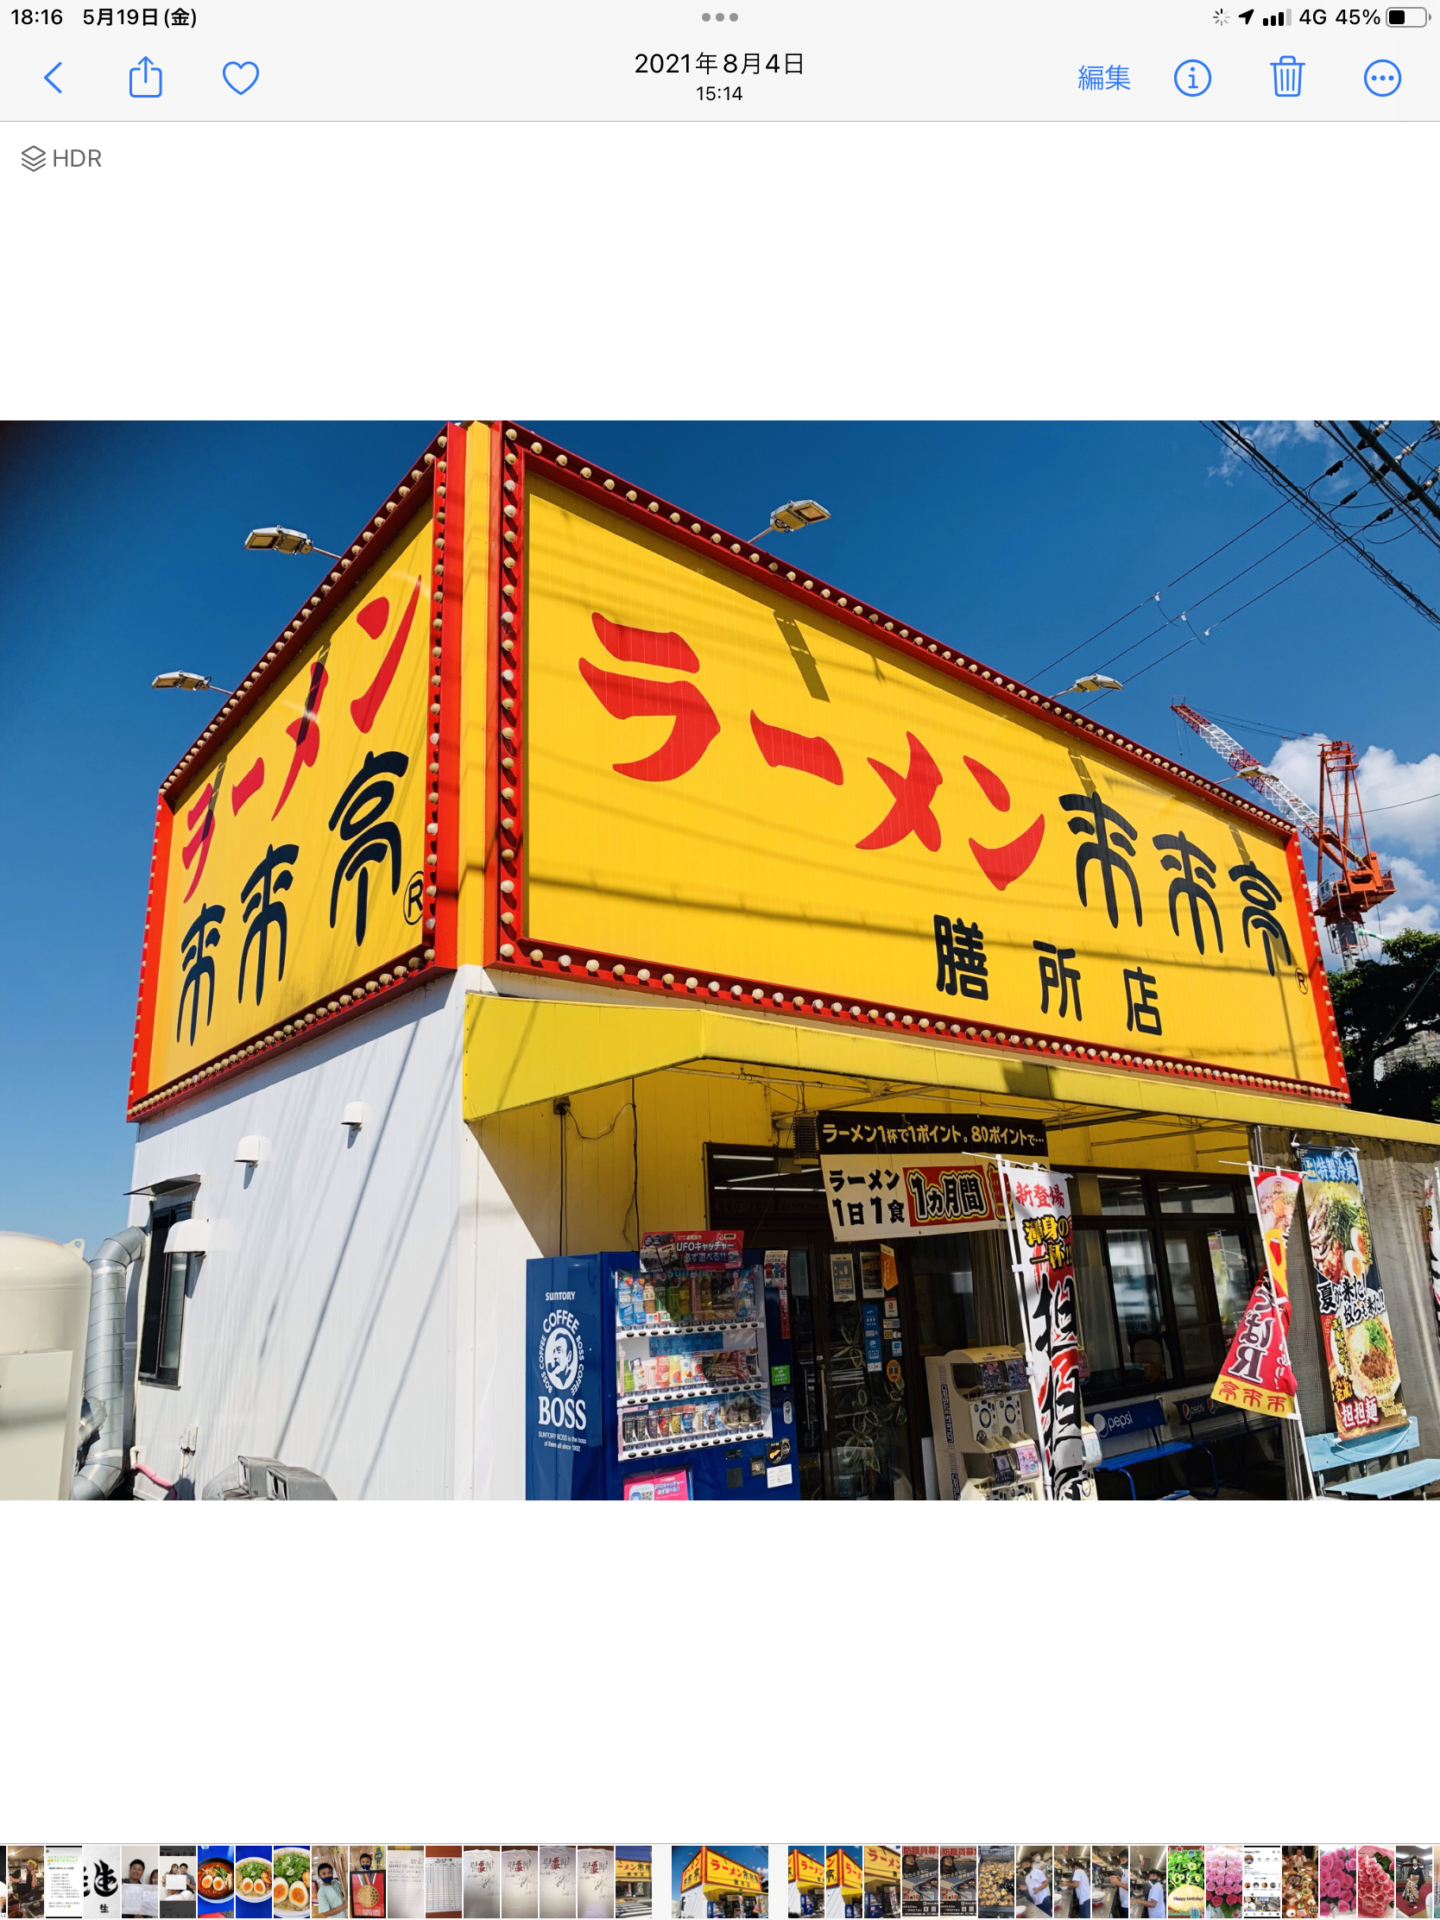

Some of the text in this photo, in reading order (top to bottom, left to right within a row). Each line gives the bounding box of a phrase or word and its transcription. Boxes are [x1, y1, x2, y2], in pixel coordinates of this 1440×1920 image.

[182, 574, 421, 903] ラーメン
[578, 611, 1045, 891] ラーメン
[1059, 790, 1291, 976] 来来亭
[176, 750, 409, 1047] 来来亭
[933, 914, 1162, 1036] 膳所店
[829, 1169, 900, 1192] ラーメン
[1016, 1181, 1065, 1209] 新登場
[832, 1197, 905, 1227] 1日1食
[543, 1309, 580, 1335] COFFEE
[538, 1334, 547, 1370] COFFEE
[571, 1364, 585, 1396] COFFEE
[538, 1396, 587, 1431] BOSS
[1107, 1411, 1134, 1432] pepsi
[1190, 1403, 1205, 1416] pepsi
